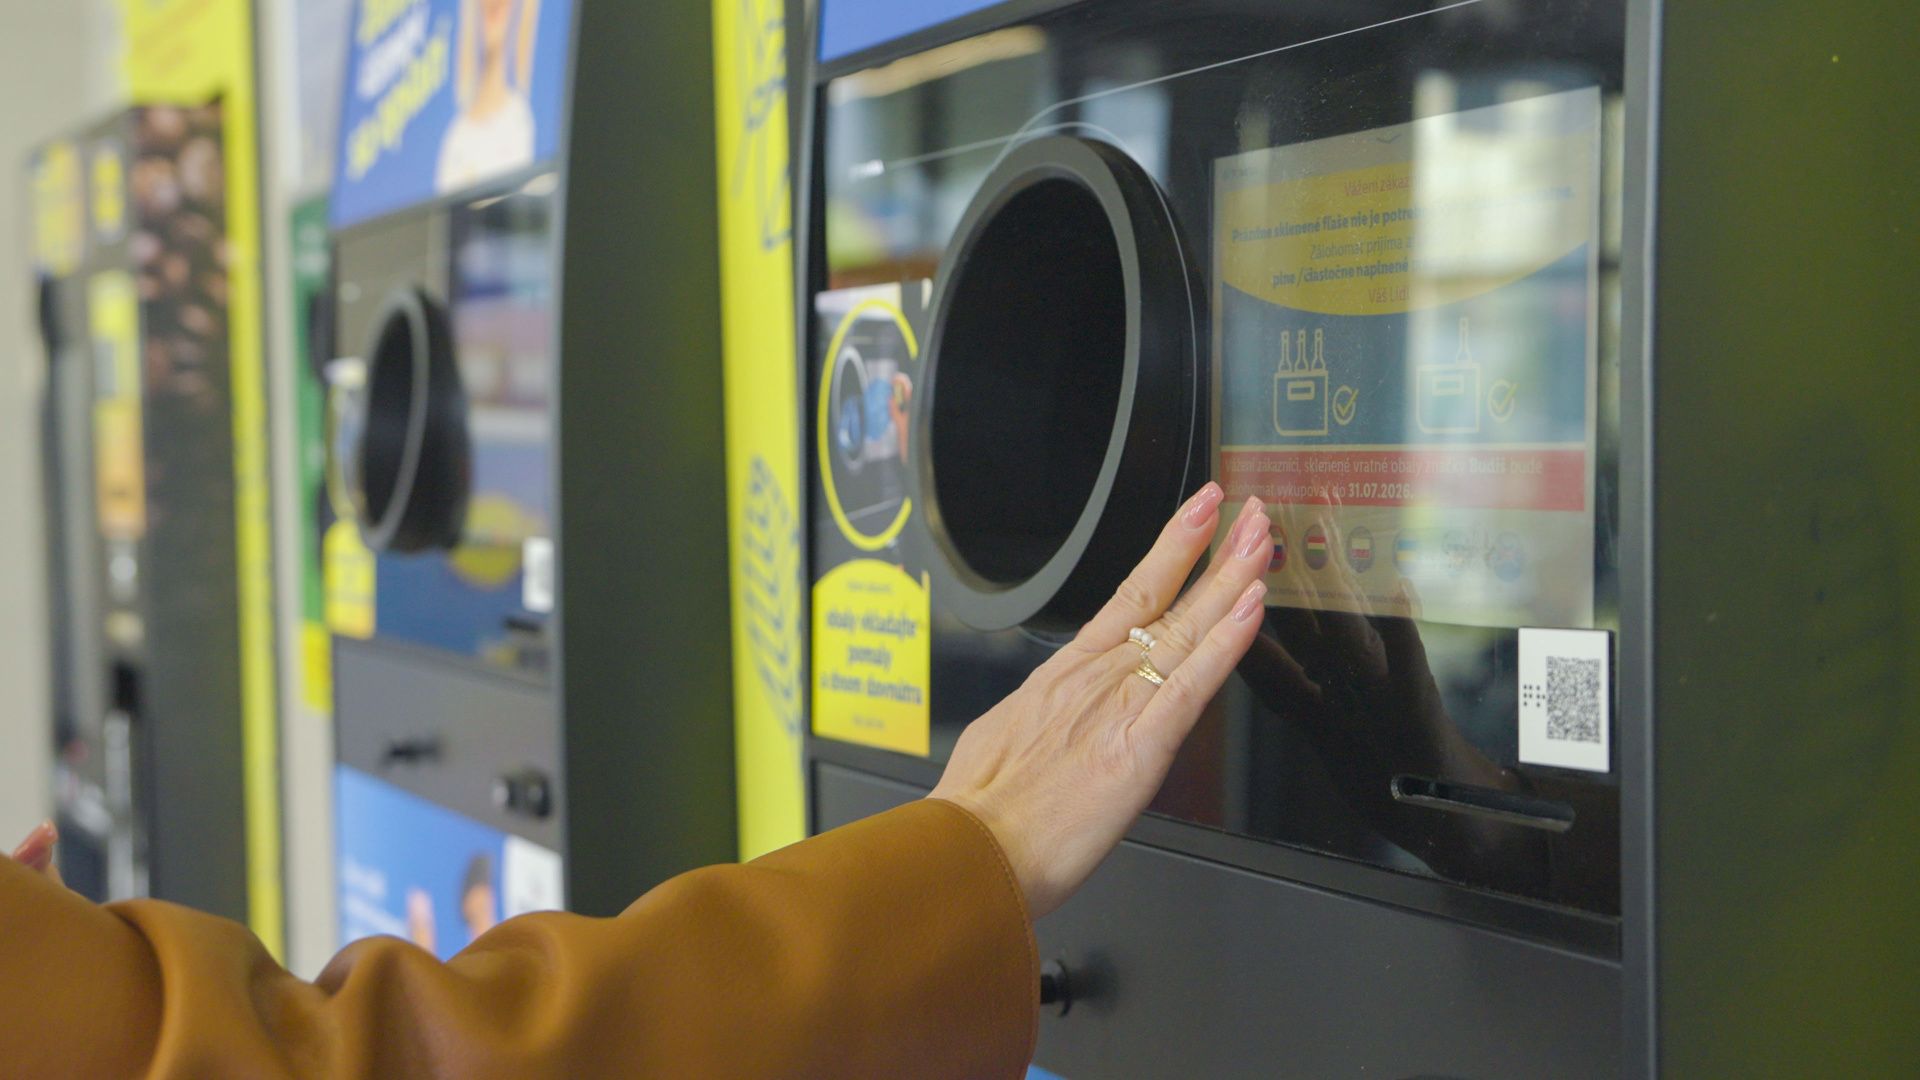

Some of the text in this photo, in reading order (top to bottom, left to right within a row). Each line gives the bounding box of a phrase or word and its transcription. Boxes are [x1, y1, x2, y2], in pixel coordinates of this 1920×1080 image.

[1350, 209, 1368, 227] nie
[1369, 208, 1380, 229] je
[1353, 458, 1388, 473] vratné
[1391, 458, 1423, 476] obaly
[1510, 456, 1543, 475] bude
